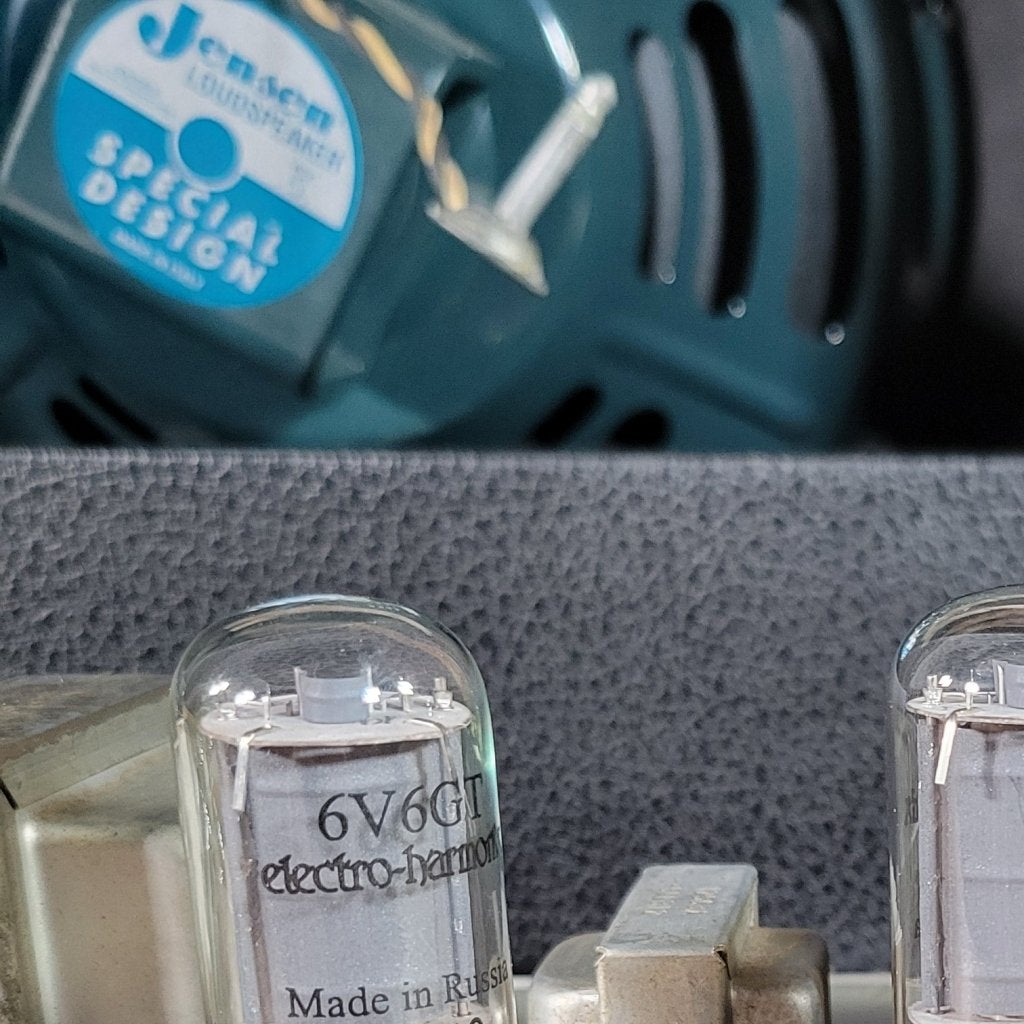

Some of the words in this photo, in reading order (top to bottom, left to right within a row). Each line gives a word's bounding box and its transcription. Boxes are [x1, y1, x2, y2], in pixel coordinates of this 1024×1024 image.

[138, 2, 335, 131] Jensen
[186, 64, 344, 172] LOUDSPEAKER
[80, 168, 268, 294] DESIGN
[87, 130, 284, 268] SPECIAL
[317, 773, 484, 842] 6V6GT
[285, 986, 390, 1018] Made
[403, 981, 434, 1012] in
[441, 956, 510, 1004] Russia
